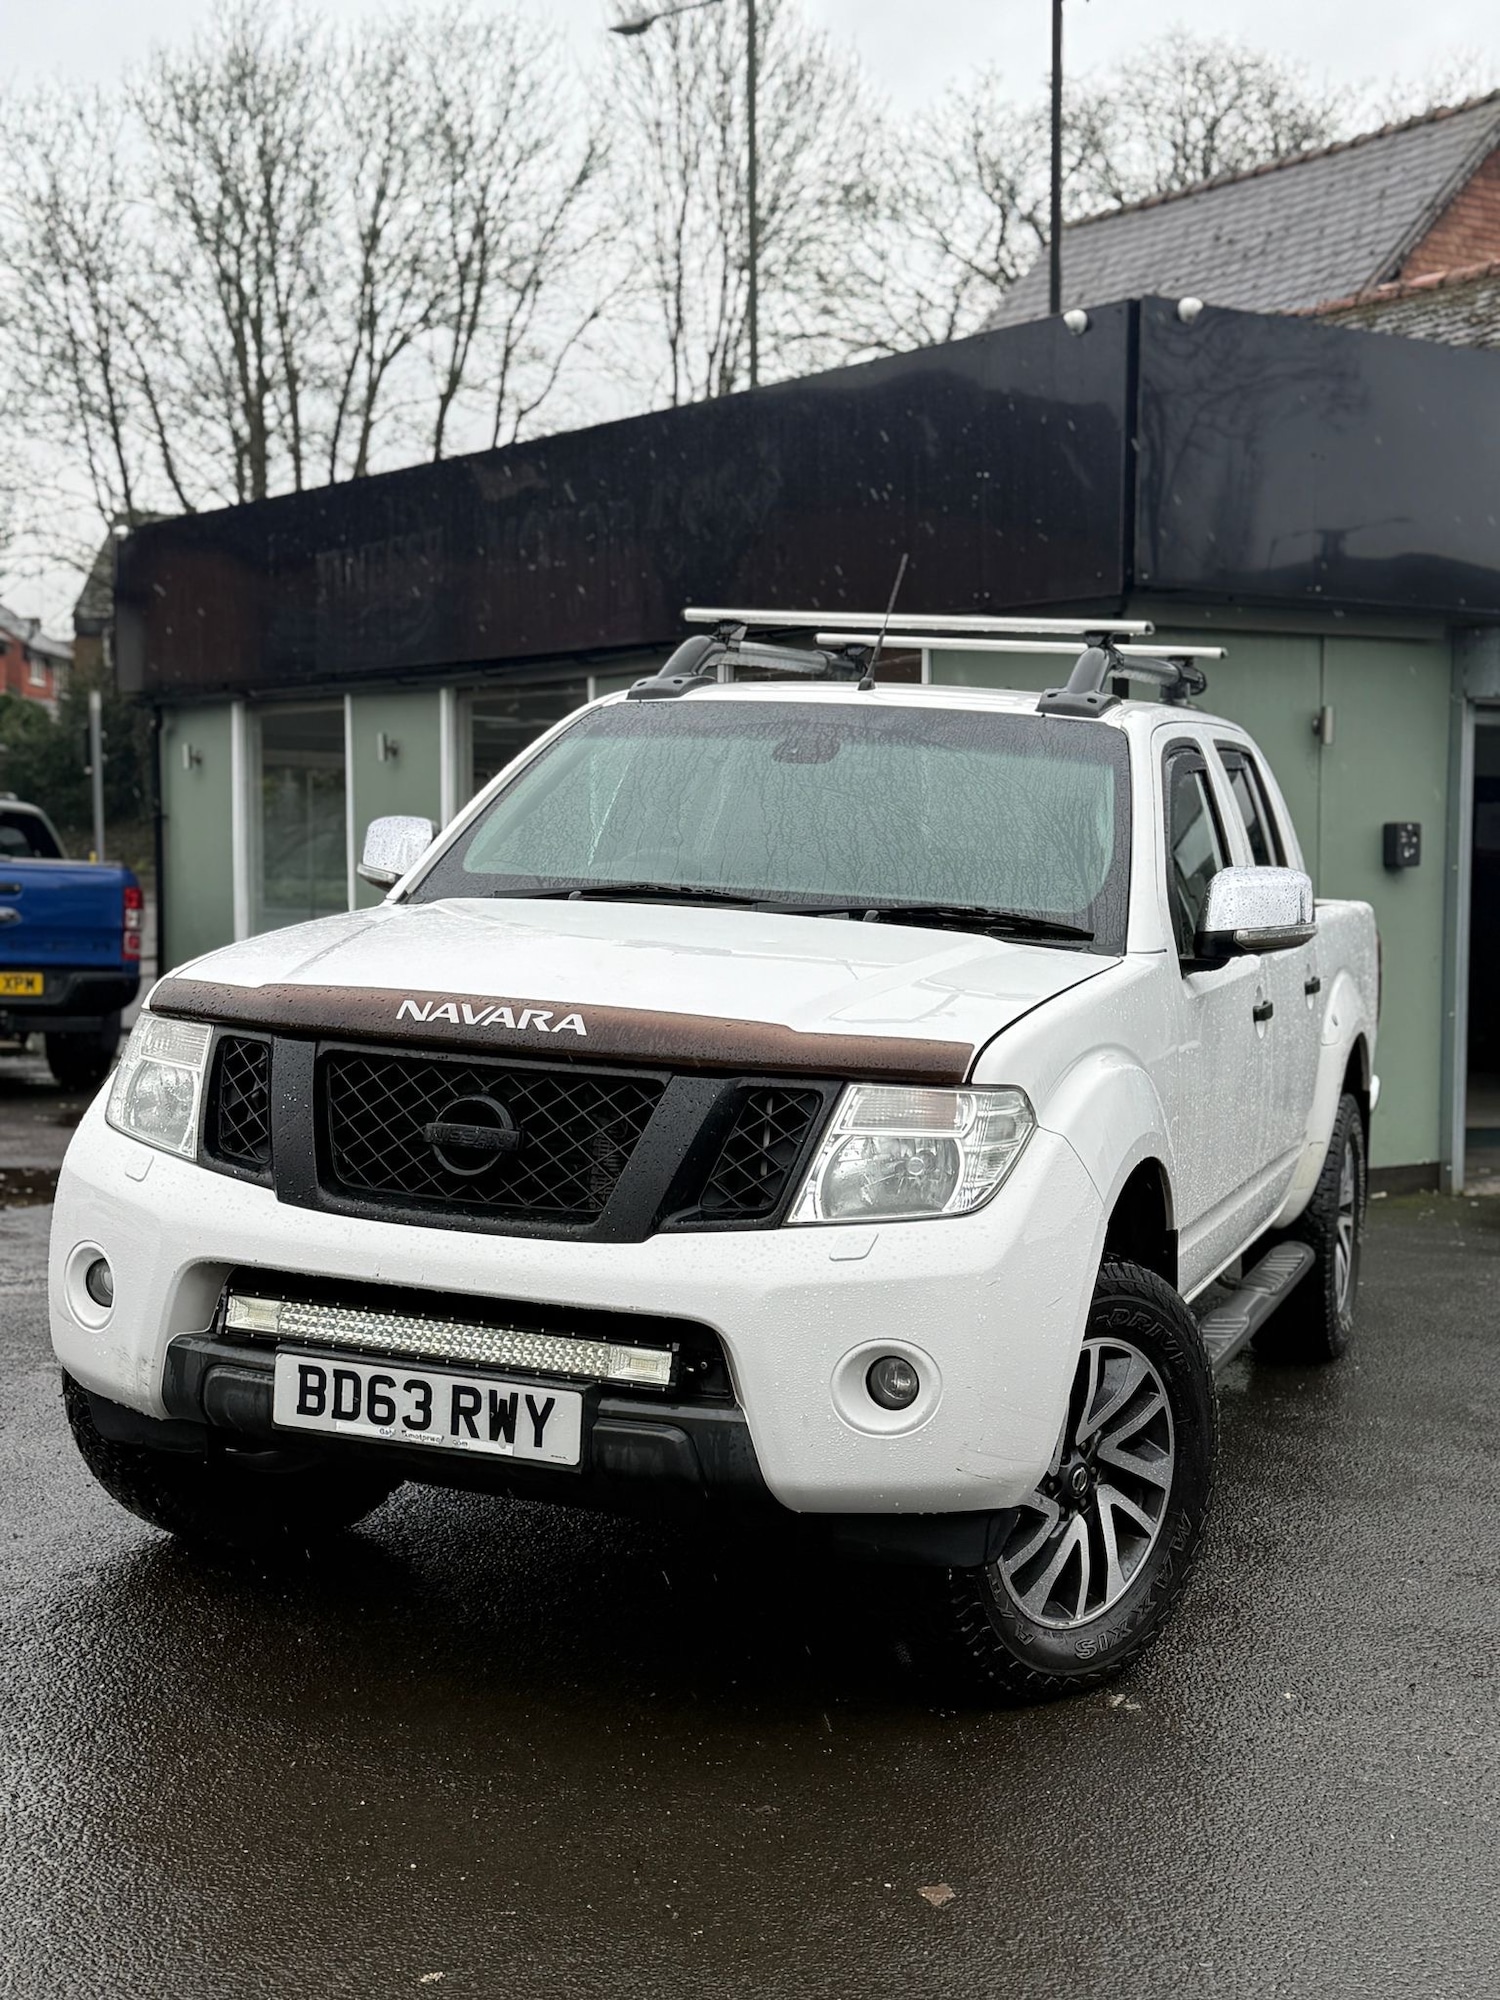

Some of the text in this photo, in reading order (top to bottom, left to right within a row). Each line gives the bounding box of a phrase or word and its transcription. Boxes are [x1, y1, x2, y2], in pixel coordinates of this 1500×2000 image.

[396, 1000, 587, 1036] NAVARA
[296, 1364, 556, 1448] BD63 RWY
[1074, 1509, 1192, 1659] MAXXIS
